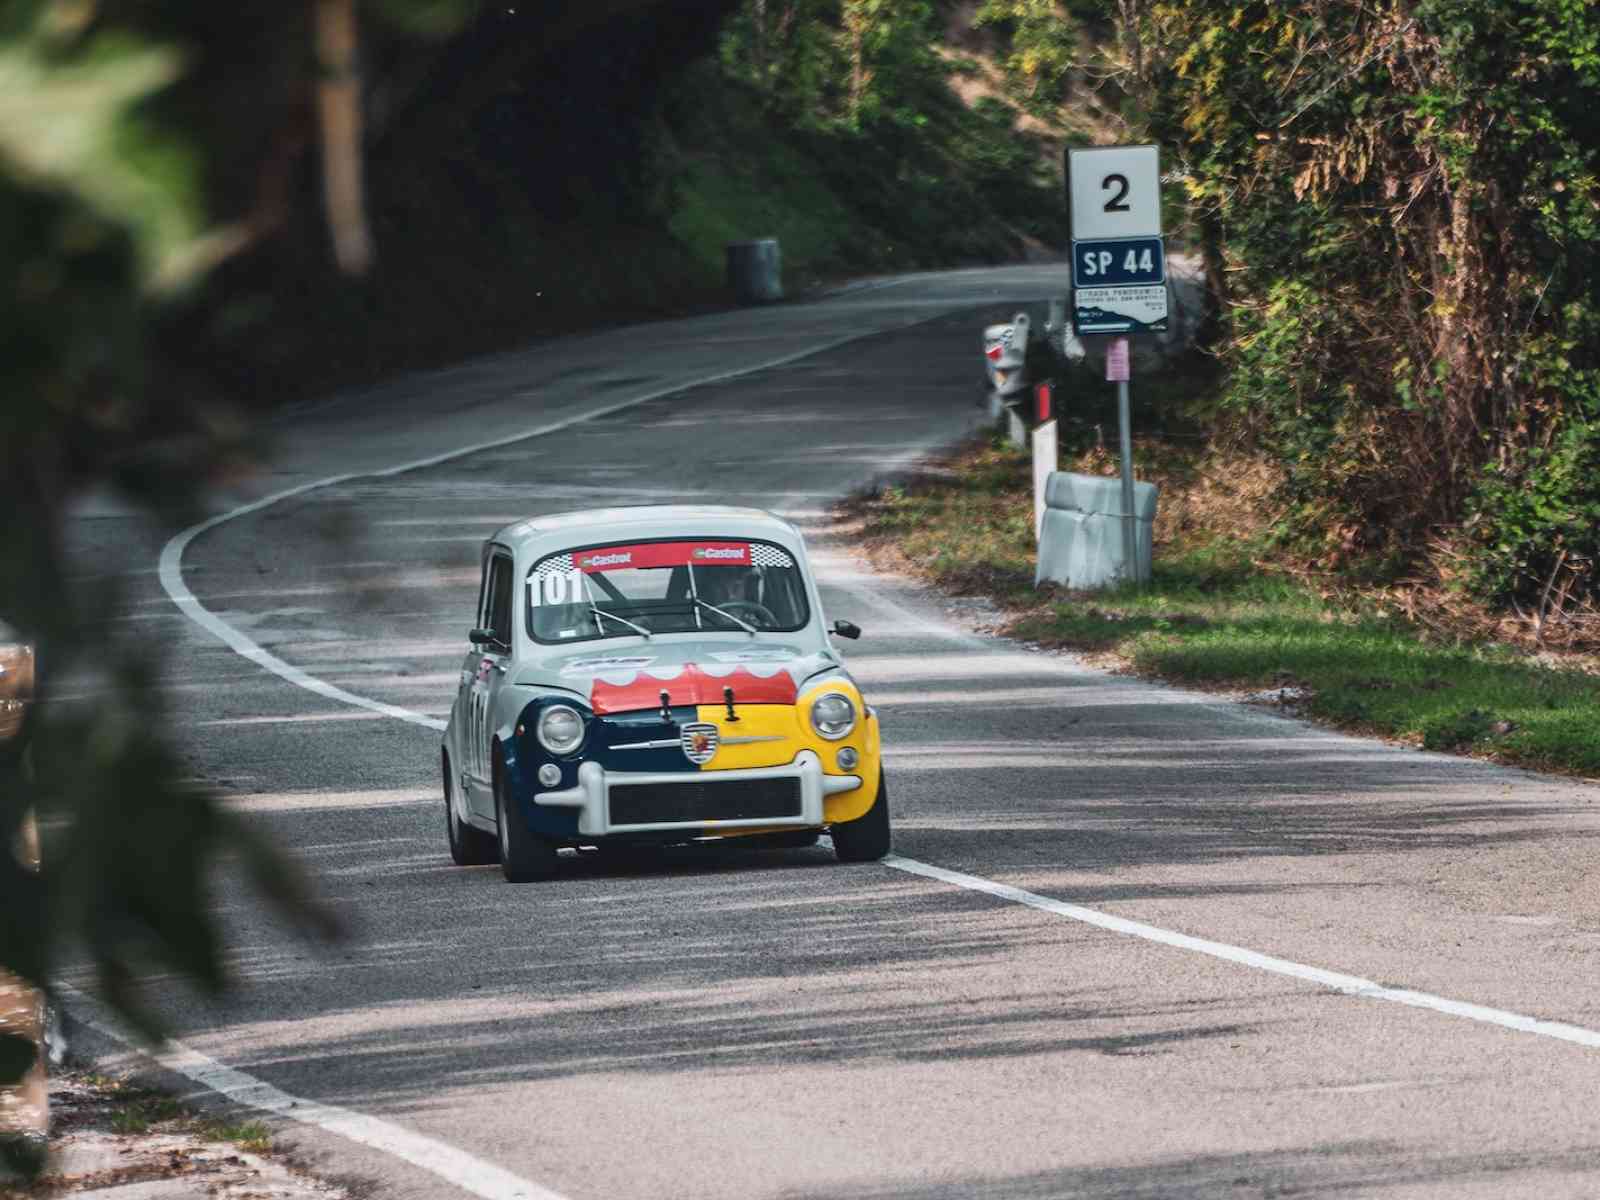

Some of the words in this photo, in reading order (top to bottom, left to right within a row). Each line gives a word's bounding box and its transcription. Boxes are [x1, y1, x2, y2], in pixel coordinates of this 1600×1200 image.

[1102, 173, 1131, 212] 2
[1084, 251, 1113, 276] SP
[1123, 247, 1154, 274] 44
[592, 552, 632, 566] Castrol
[704, 548, 745, 559] Castrol
[526, 567, 582, 607] 101
